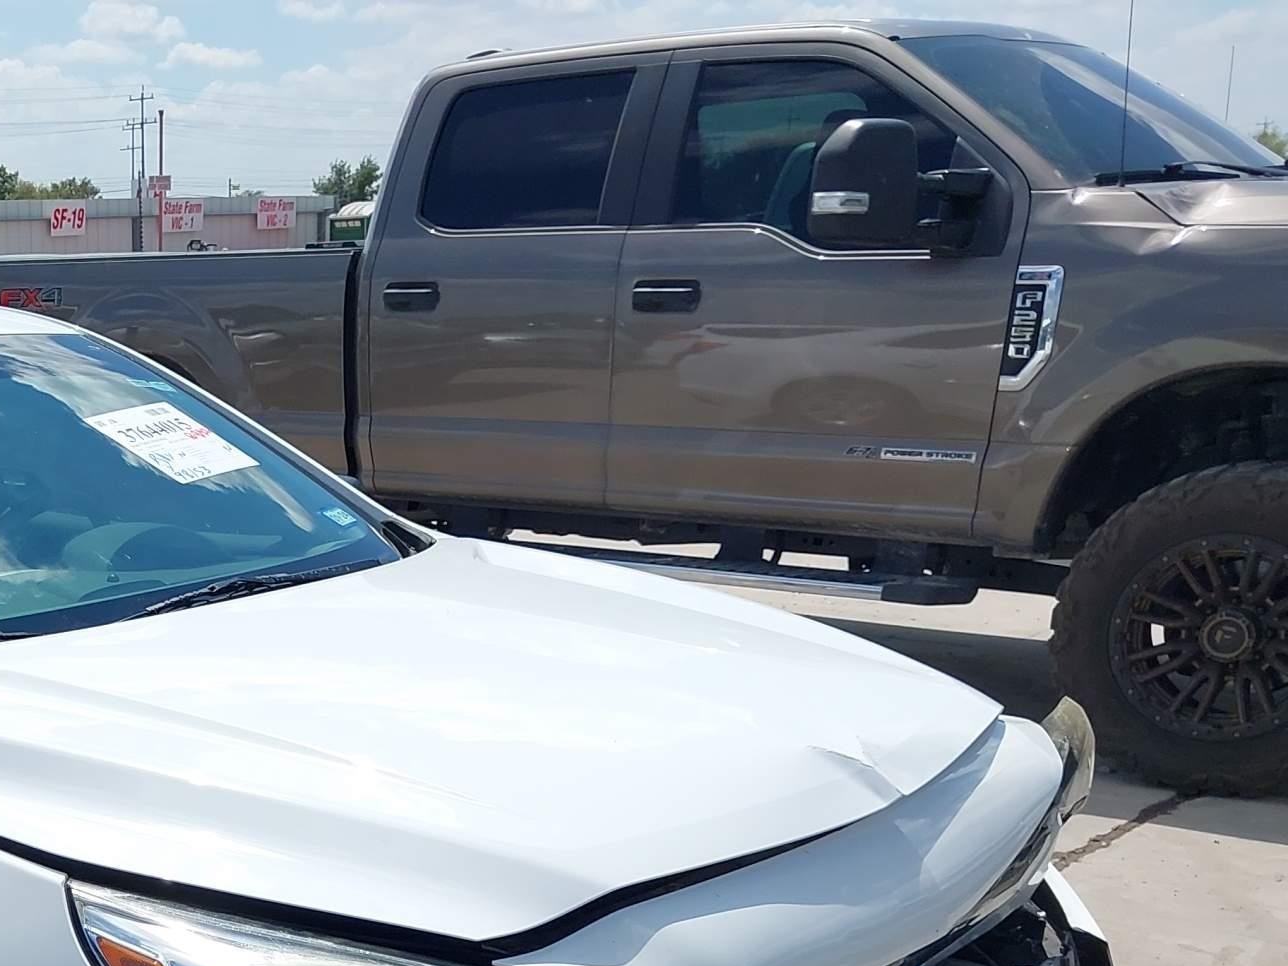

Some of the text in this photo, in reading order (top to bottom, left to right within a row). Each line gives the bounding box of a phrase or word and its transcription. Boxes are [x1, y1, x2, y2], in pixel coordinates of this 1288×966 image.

[164, 201, 202, 215] State Farm
[259, 199, 295, 213] State Farm
[52, 208, 85, 230] SF-19
[171, 215, 183, 230] VIC
[266, 213, 278, 227] VIC
[0, 287, 63, 308] FX4
[117, 418, 193, 443] 37644015
[926, 451, 971, 459] STROKE
